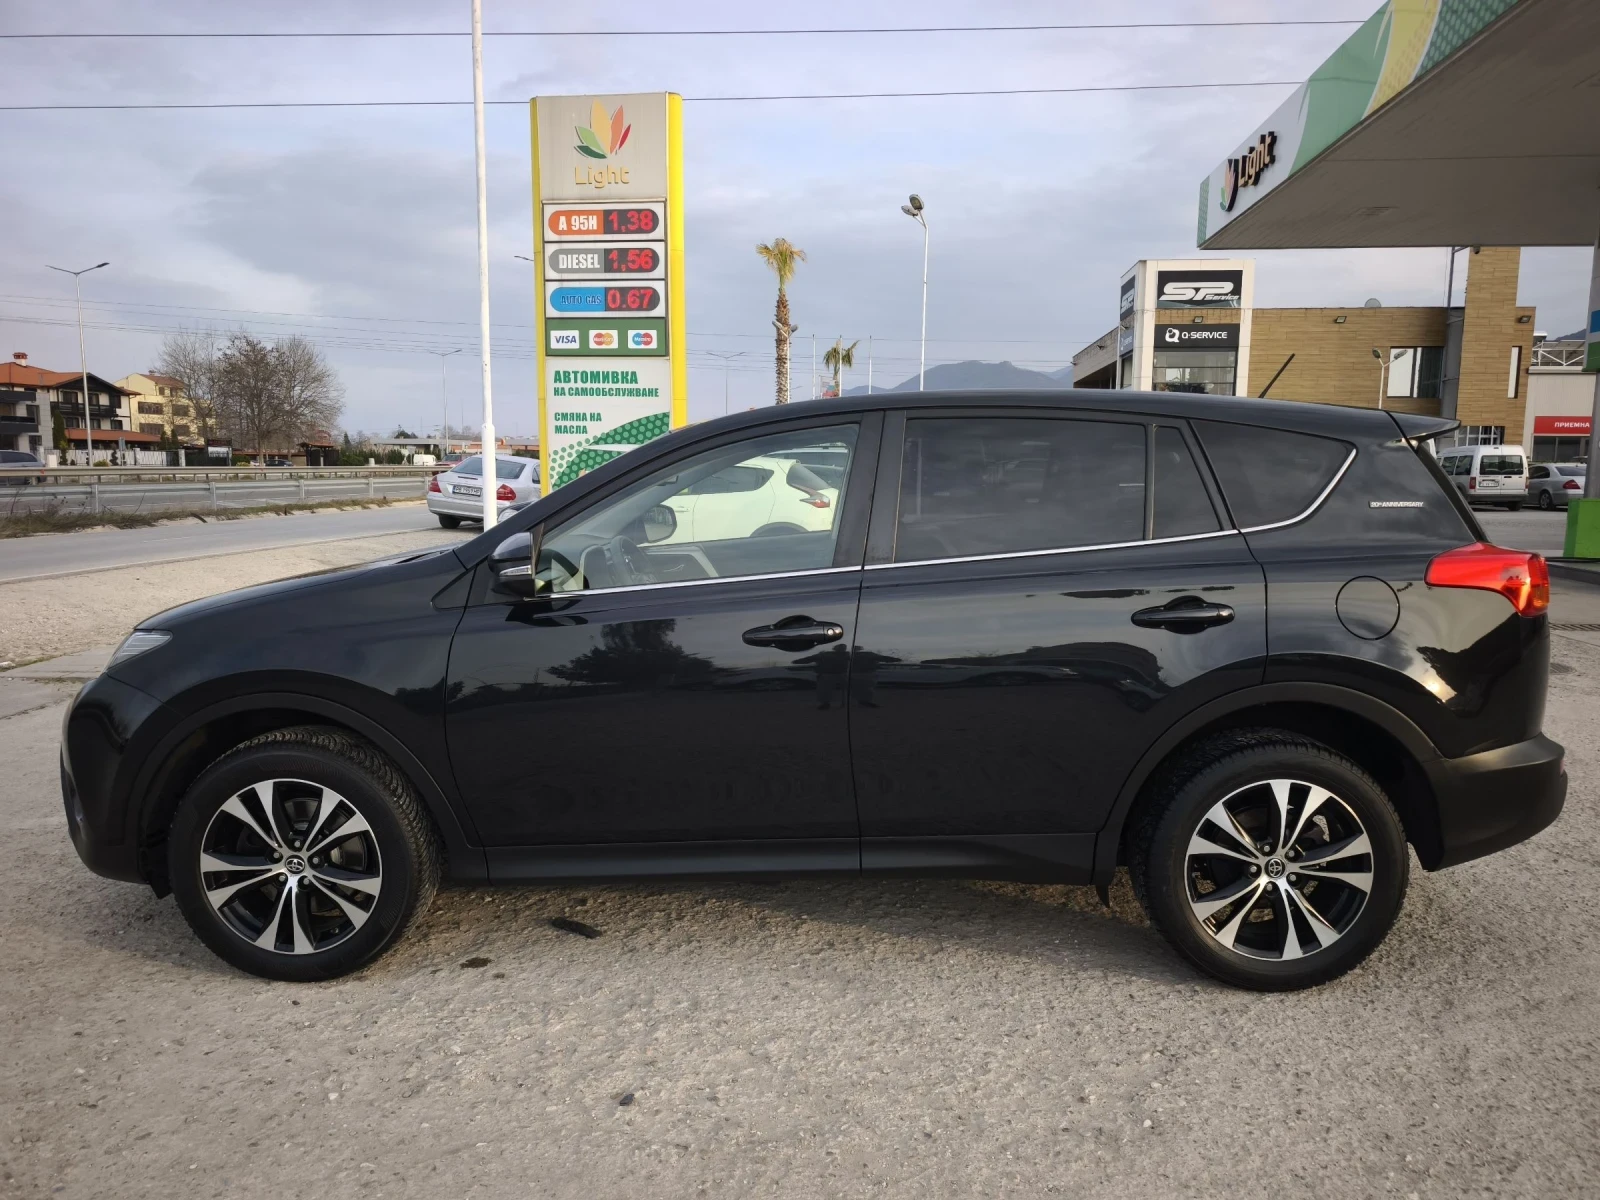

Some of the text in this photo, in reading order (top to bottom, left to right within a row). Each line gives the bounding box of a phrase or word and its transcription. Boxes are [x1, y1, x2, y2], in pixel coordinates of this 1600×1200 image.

[1238, 131, 1277, 187] Light
[574, 165, 630, 189] Light
[558, 215, 597, 230] A 95H
[558, 254, 600, 269] DIESEL
[1159, 281, 1234, 300] SP
[561, 295, 601, 304] AUTO GAS
[1203, 293, 1240, 301] Service
[554, 335, 577, 344] VISA
[553, 370, 639, 385] АВТОМИВКА
[553, 387, 660, 397] НА САМООБСЛУЖВАНЕ
[554, 412, 602, 422] СМЯНА НА
[554, 425, 588, 435] МАСЛА
